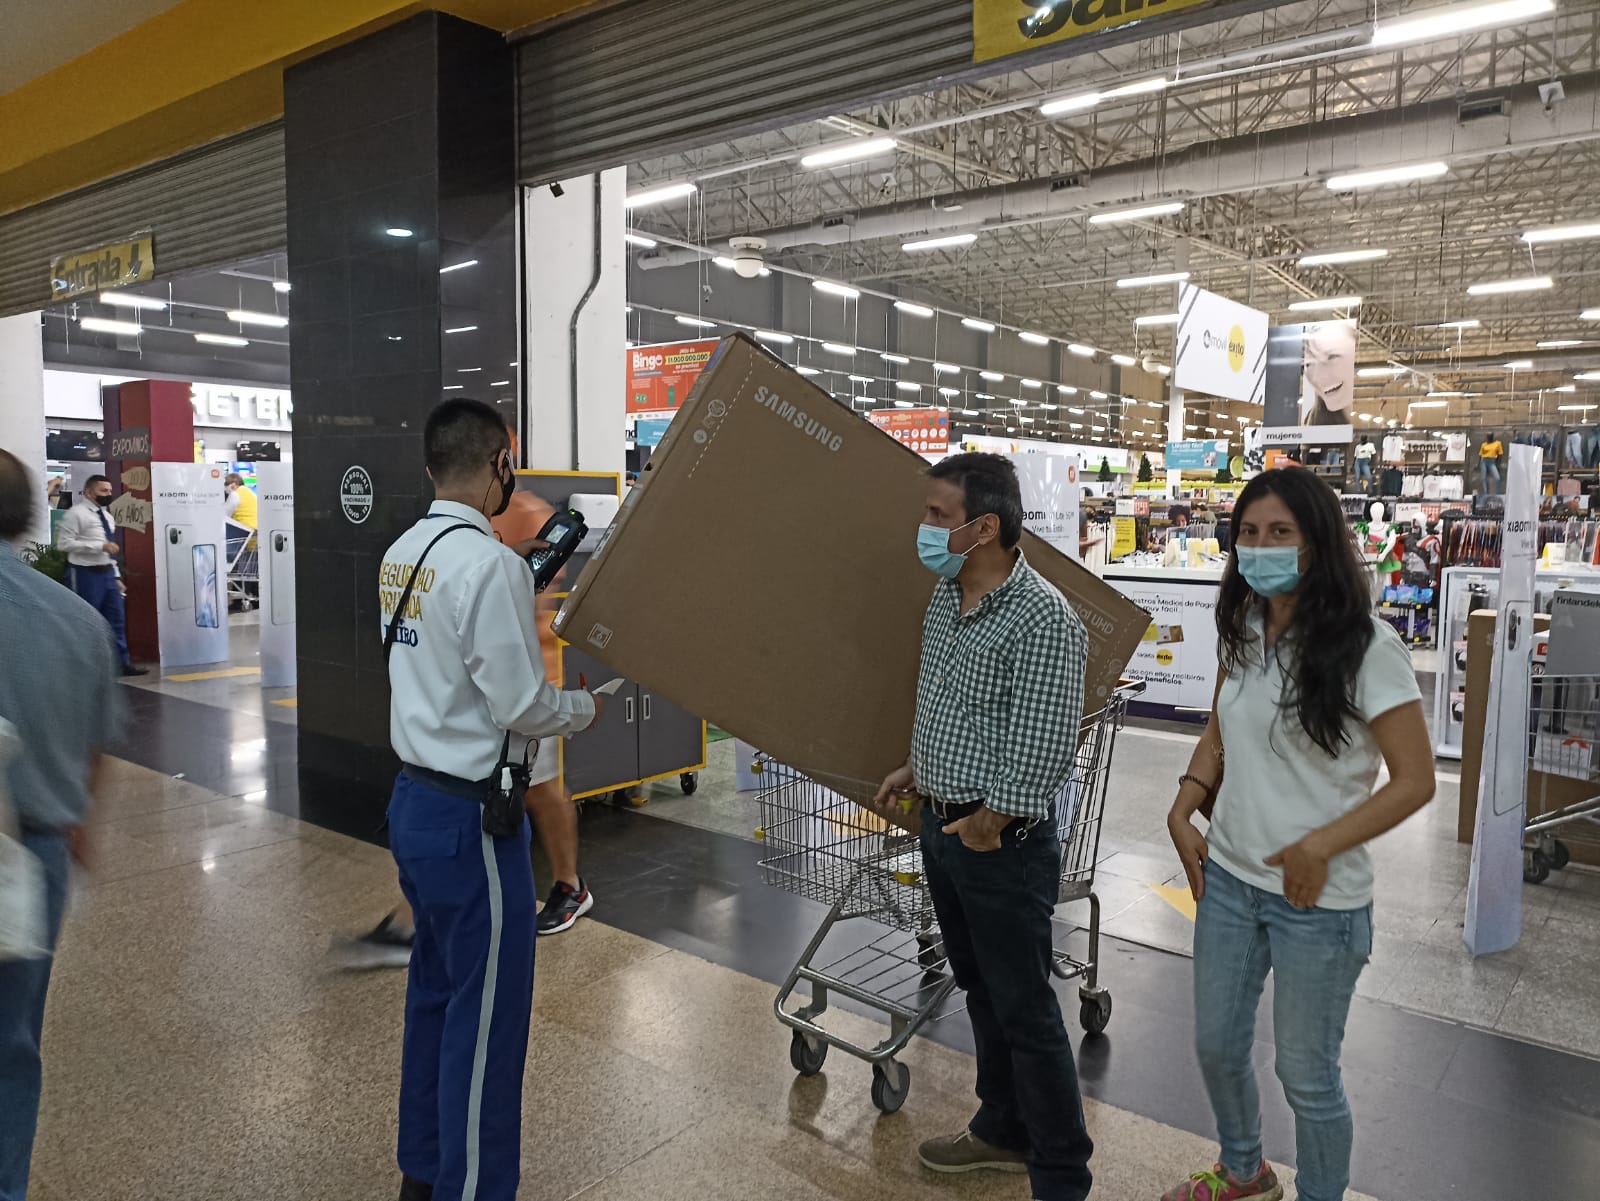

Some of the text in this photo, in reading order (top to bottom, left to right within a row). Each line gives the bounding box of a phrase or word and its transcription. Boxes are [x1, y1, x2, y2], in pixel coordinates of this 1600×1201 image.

[632, 351, 663, 370] Bingo
[754, 385, 843, 452] SAMSUNG
[1266, 432, 1303, 441] mujeres
[1091, 614, 1114, 635] UHD
